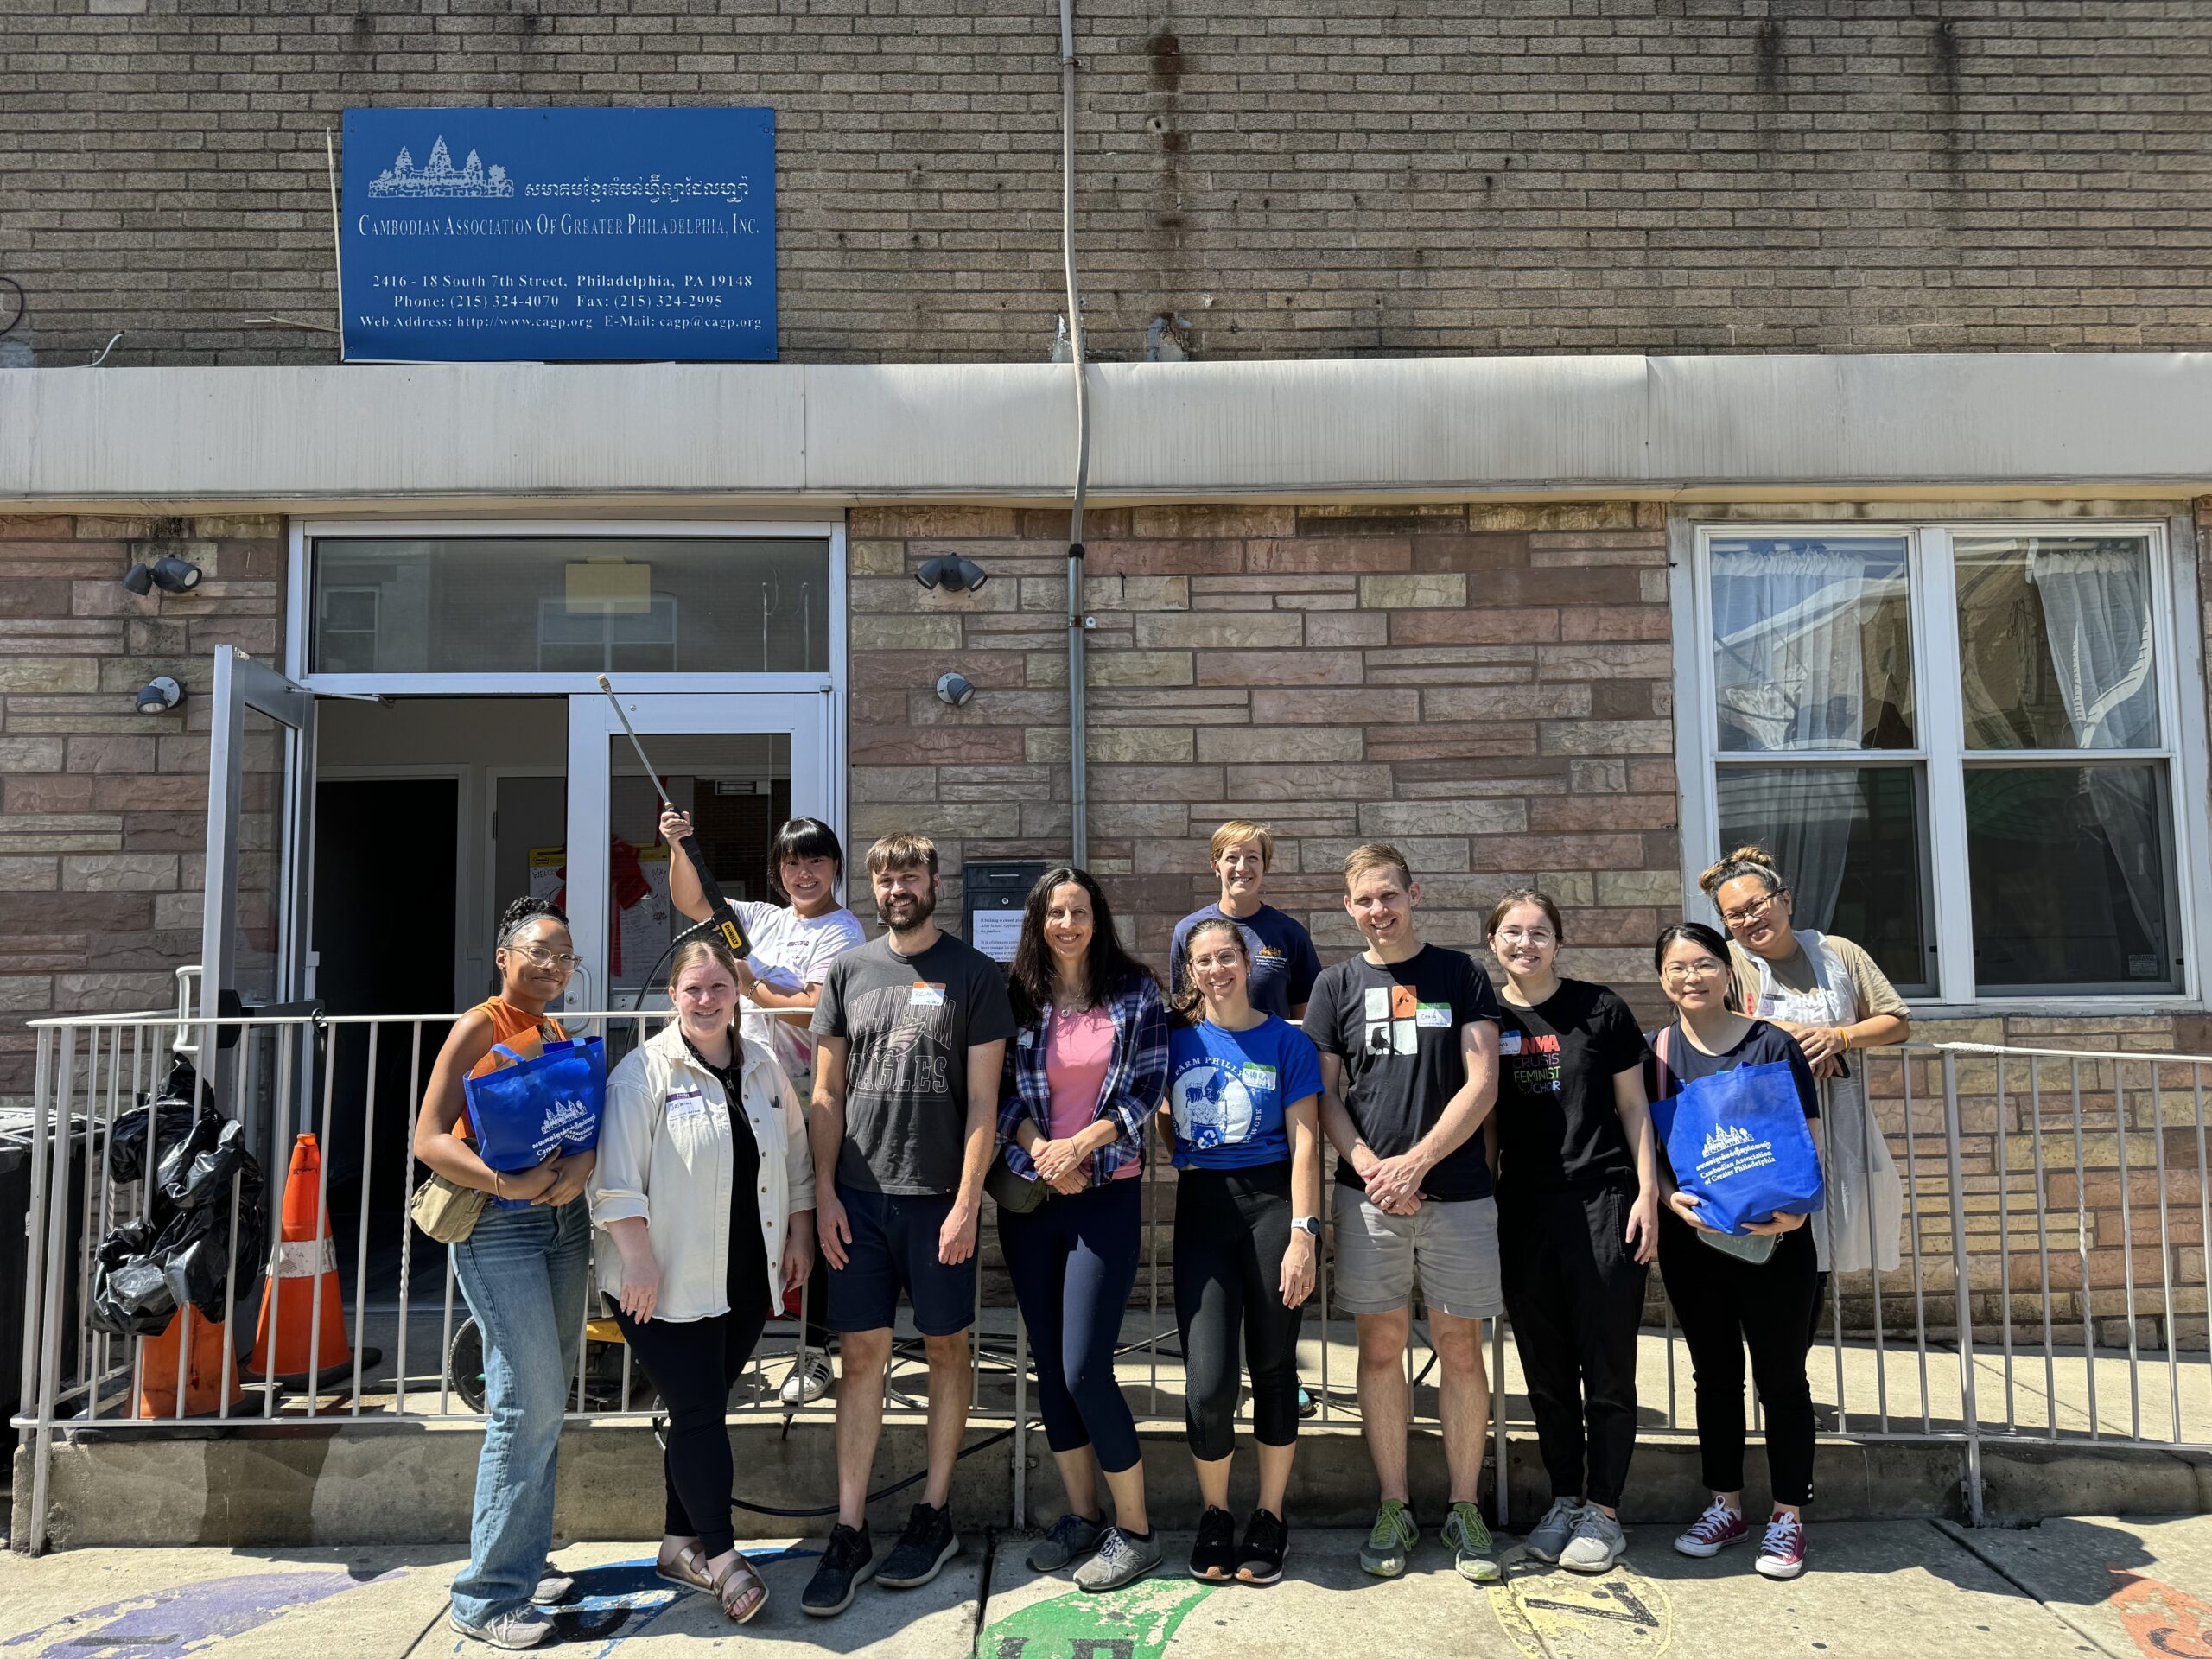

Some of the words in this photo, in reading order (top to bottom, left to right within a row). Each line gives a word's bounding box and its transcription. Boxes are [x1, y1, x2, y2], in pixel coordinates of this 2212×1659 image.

[359, 213, 440, 236] CAMBODIAN
[444, 214, 533, 236] ASSOCIATION
[561, 213, 624, 235] GREATER
[627, 213, 728, 238] PHILADELPHIA,
[732, 213, 760, 235] INC.
[372, 275, 407, 287] 2416
[423, 275, 438, 287] 18
[442, 275, 486, 287] South
[491, 275, 514, 287] 7th
[518, 275, 568, 289] Street,
[577, 275, 675, 289] Philadelphia,
[684, 275, 704, 287] PA
[711, 275, 753, 287] 19148
[394, 295, 445, 307] Phone:
[450, 295, 487, 309] (215)
[492, 295, 559, 307] 324-4070
[576, 295, 608, 307] Fax:
[613, 295, 651, 309] (215)
[656, 295, 722, 307] 324-2995
[359, 315, 389, 327] Web
[393, 315, 452, 327] Address:
[457, 315, 593, 329] http://www.cagp.org
[605, 315, 655, 327] E-Mail:
[659, 315, 762, 329] cagp@cagp.org
[1521, 1034, 1561, 1055] NNA
[1175, 1057, 1201, 1076] FARM
[1512, 1052, 1560, 1069] CRUSIS
[845, 1052, 949, 1094] EAGLES
[1514, 1065, 1562, 1084] FEMINIST
[1532, 1080, 1561, 1094] CHOIR
[1700, 1161, 1735, 1179] Cambodian
[1735, 1151, 1772, 1166] Association
[1704, 1177, 1712, 1185] of
[1711, 1169, 1734, 1182] Greater
[1733, 1156, 1777, 1173] Philadelphia
